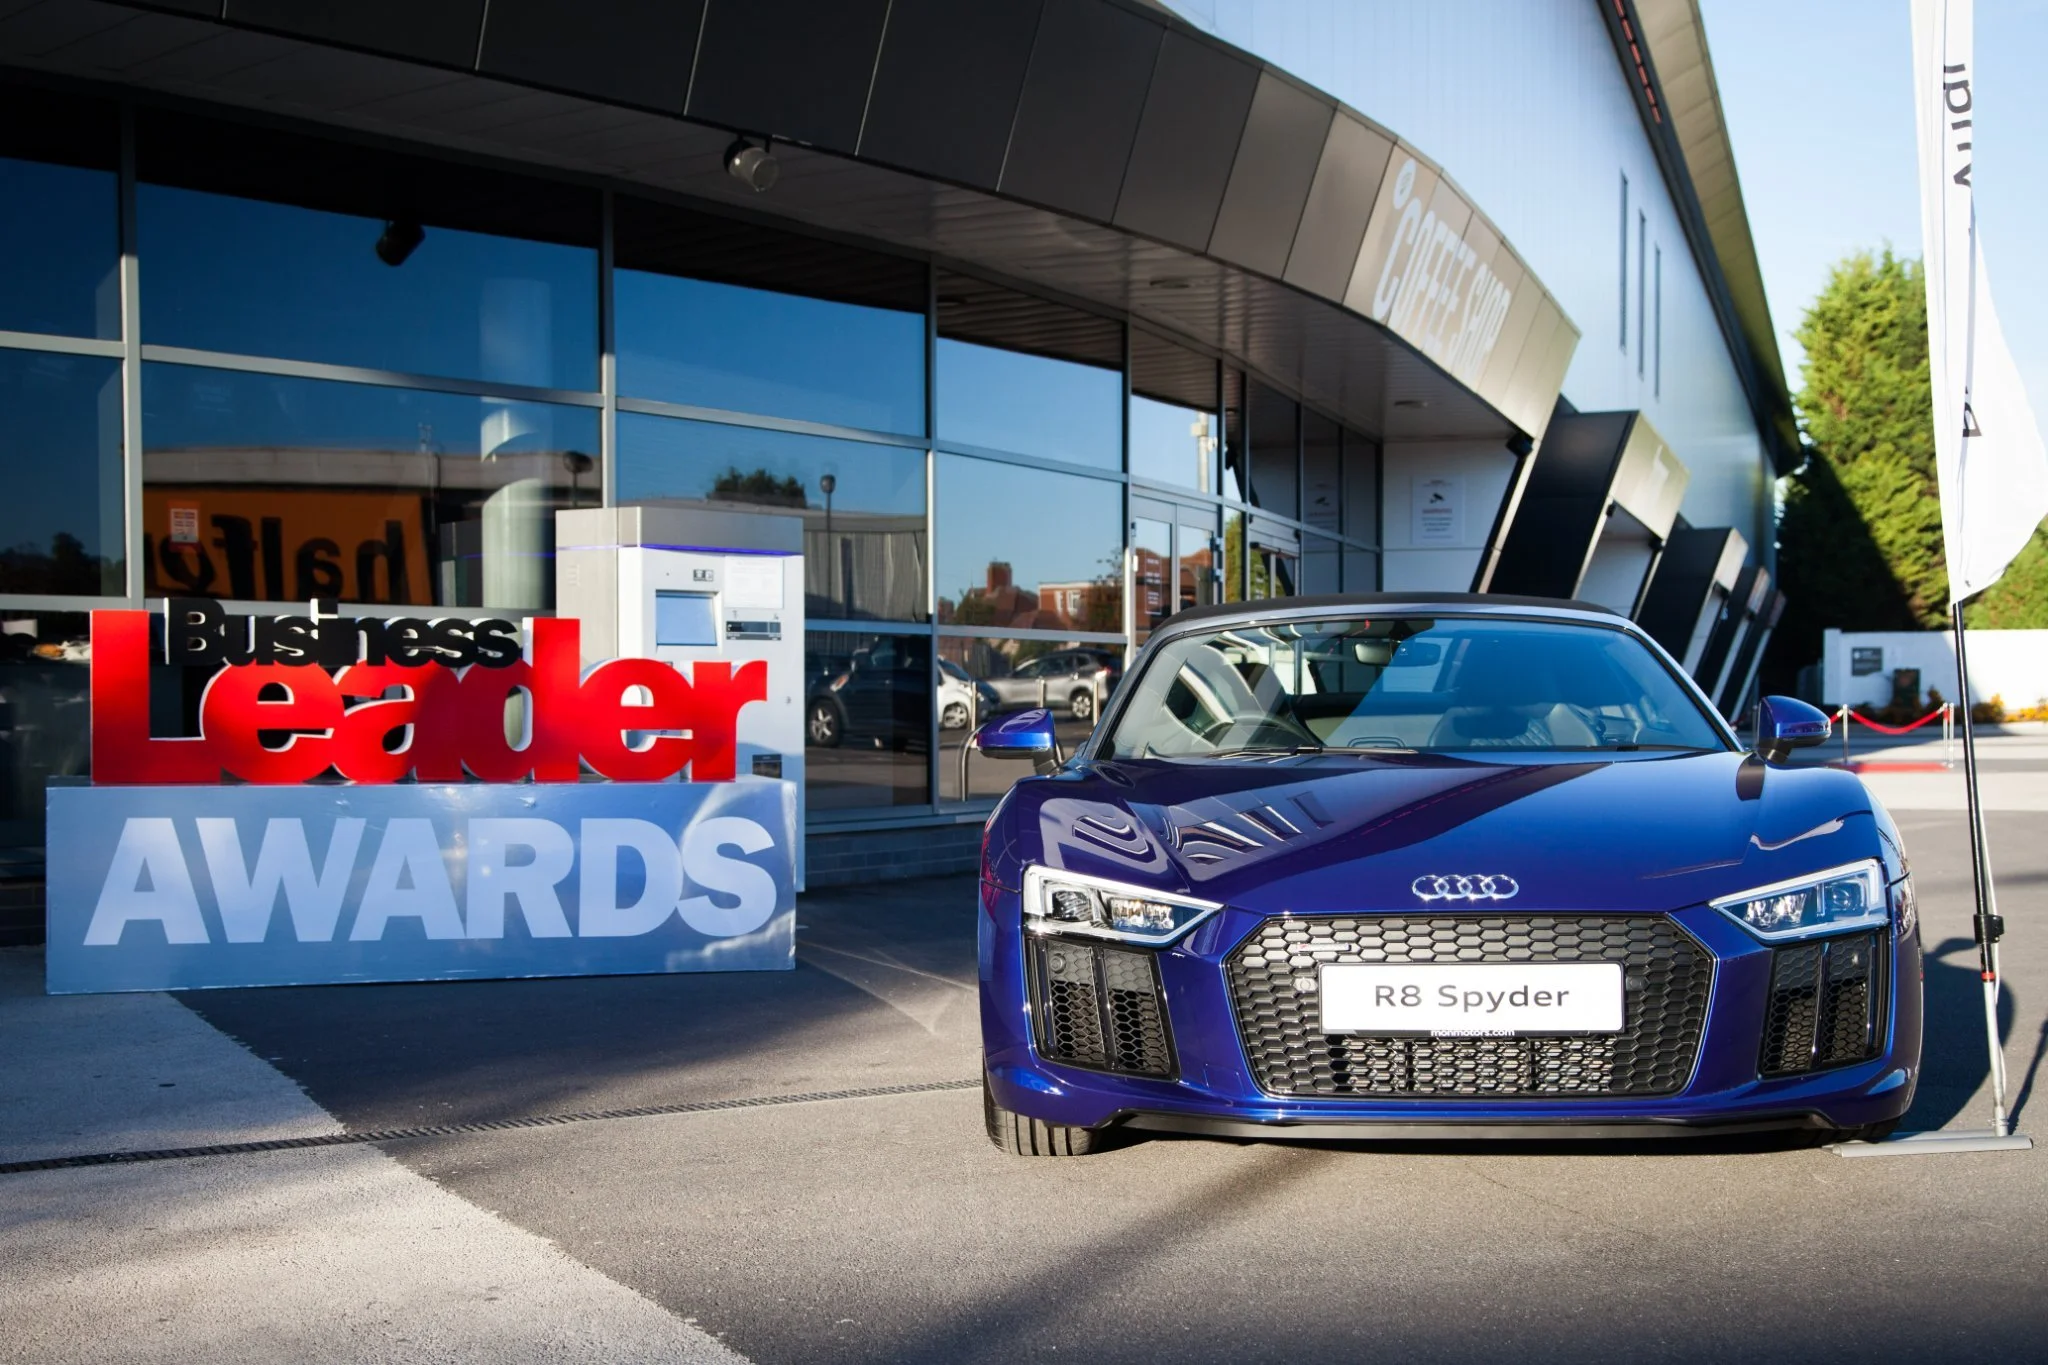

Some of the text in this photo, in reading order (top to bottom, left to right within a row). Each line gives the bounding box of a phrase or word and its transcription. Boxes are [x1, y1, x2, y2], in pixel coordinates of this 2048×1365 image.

[1372, 197, 1512, 381] COFFEE SHOP
[91, 609, 768, 784] Leader
[164, 598, 520, 668] Business
[83, 816, 778, 946] AWARDS
[1374, 984, 1570, 1013] R8 Spyder
